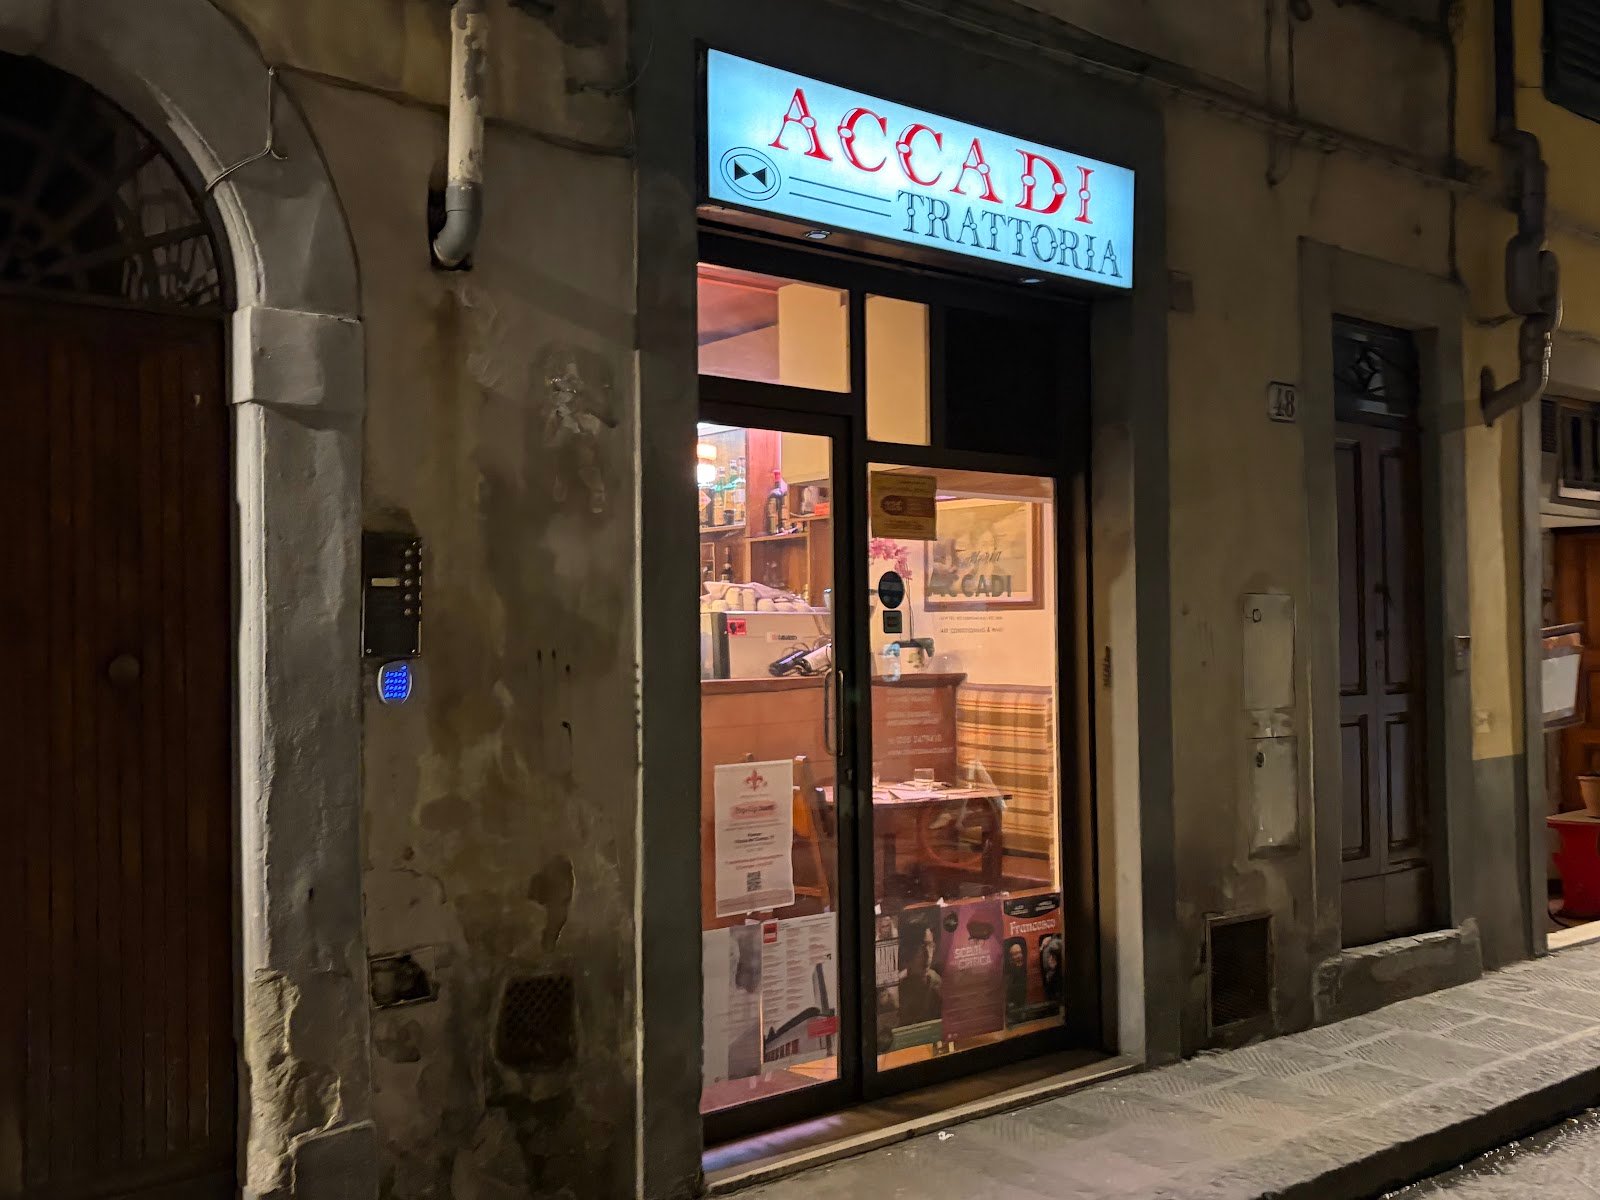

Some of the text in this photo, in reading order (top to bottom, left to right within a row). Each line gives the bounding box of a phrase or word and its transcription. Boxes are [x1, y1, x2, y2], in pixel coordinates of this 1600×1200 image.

[768, 87, 1094, 225] ACCADI
[897, 189, 1123, 278] TRATTORIA
[1272, 388, 1296, 418] 48
